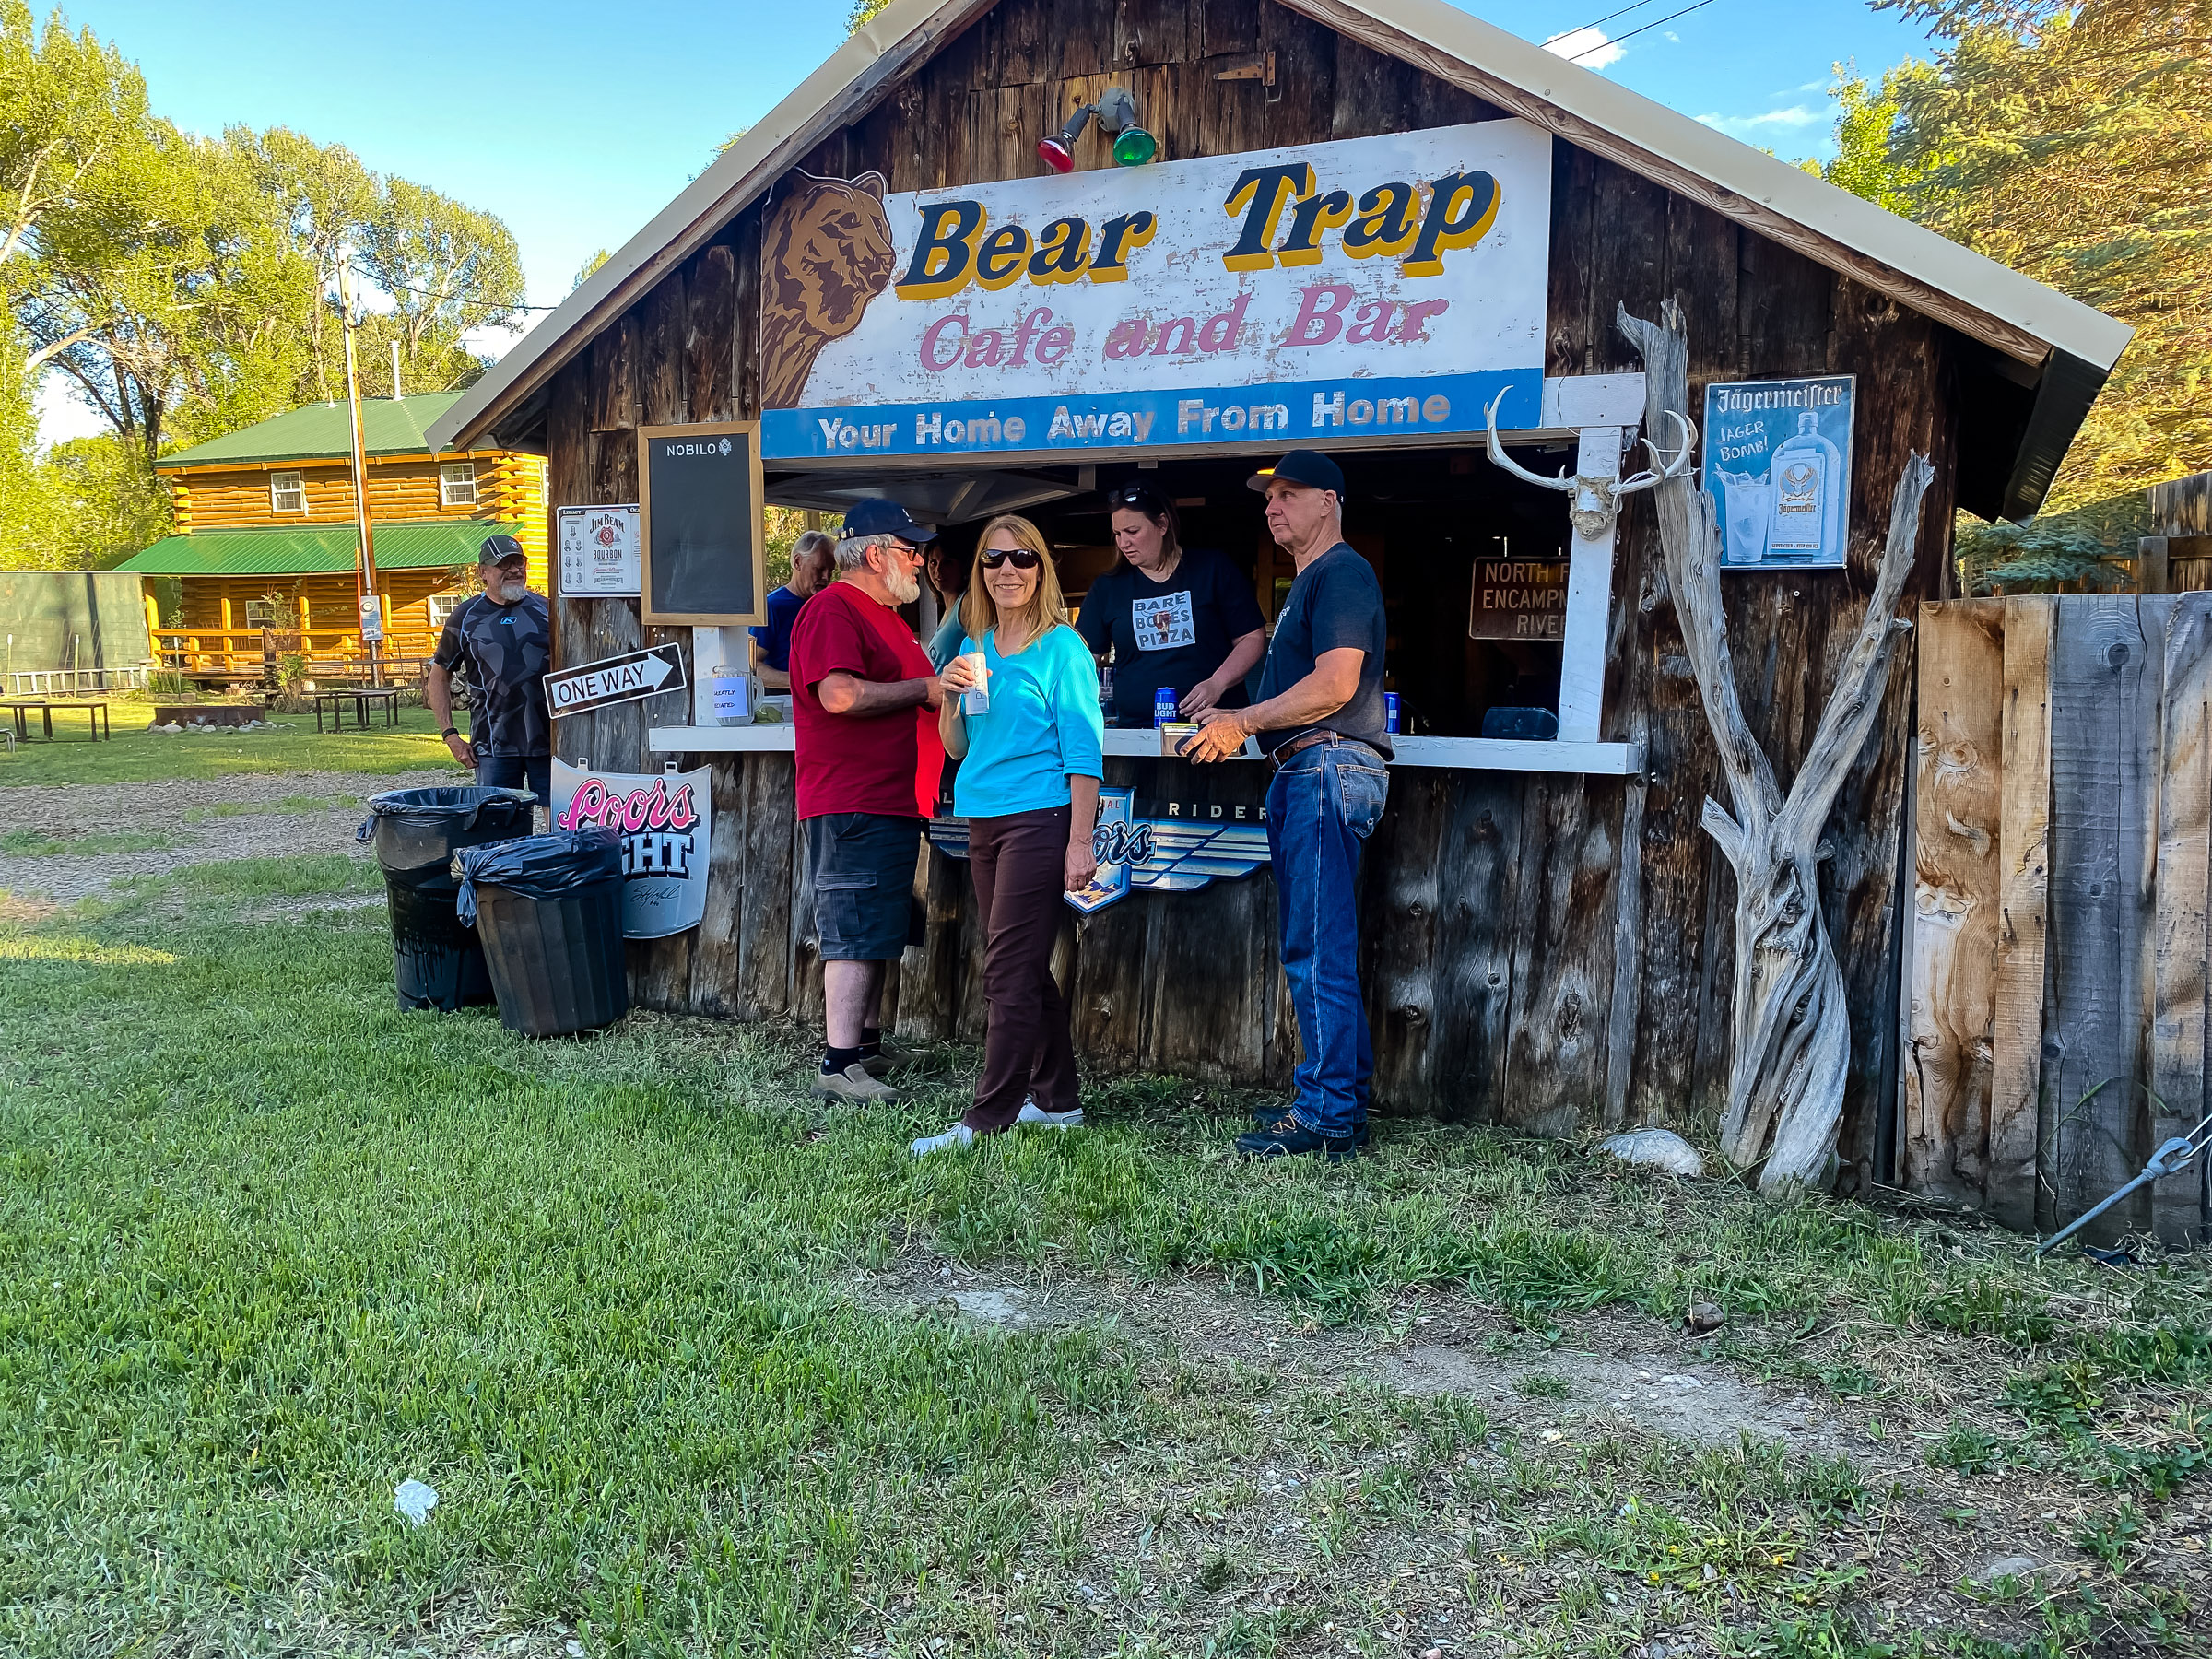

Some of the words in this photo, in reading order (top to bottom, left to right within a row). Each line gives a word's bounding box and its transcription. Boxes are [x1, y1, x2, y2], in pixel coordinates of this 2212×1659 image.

[895, 200, 1158, 300] Bear
[1222, 162, 1501, 277] Trap
[920, 307, 1072, 371] Cafe
[1106, 292, 1252, 359] and
[1278, 285, 1450, 347] Bar
[818, 418, 898, 449] Your
[915, 412, 1027, 445] Home
[1048, 406, 1156, 443] Away
[1177, 398, 1289, 434] From
[1312, 391, 1452, 428] Home
[1717, 420, 1765, 443] JAGER
[666, 443, 717, 457] NOBILO
[1719, 435, 1769, 462] BOMB!
[589, 518, 604, 534] JIM
[604, 513, 626, 534] BEAM
[593, 549, 623, 559] BOURBON
[1485, 562, 1549, 582] NORTH
[1135, 594, 1187, 612] BARE
[1135, 609, 1190, 629] BOES
[1139, 628, 1193, 647] PIZZA
[558, 676, 599, 704] ONE
[601, 664, 645, 694] WAY
[1156, 702, 1175, 711] BUD
[557, 778, 700, 831] Coors
